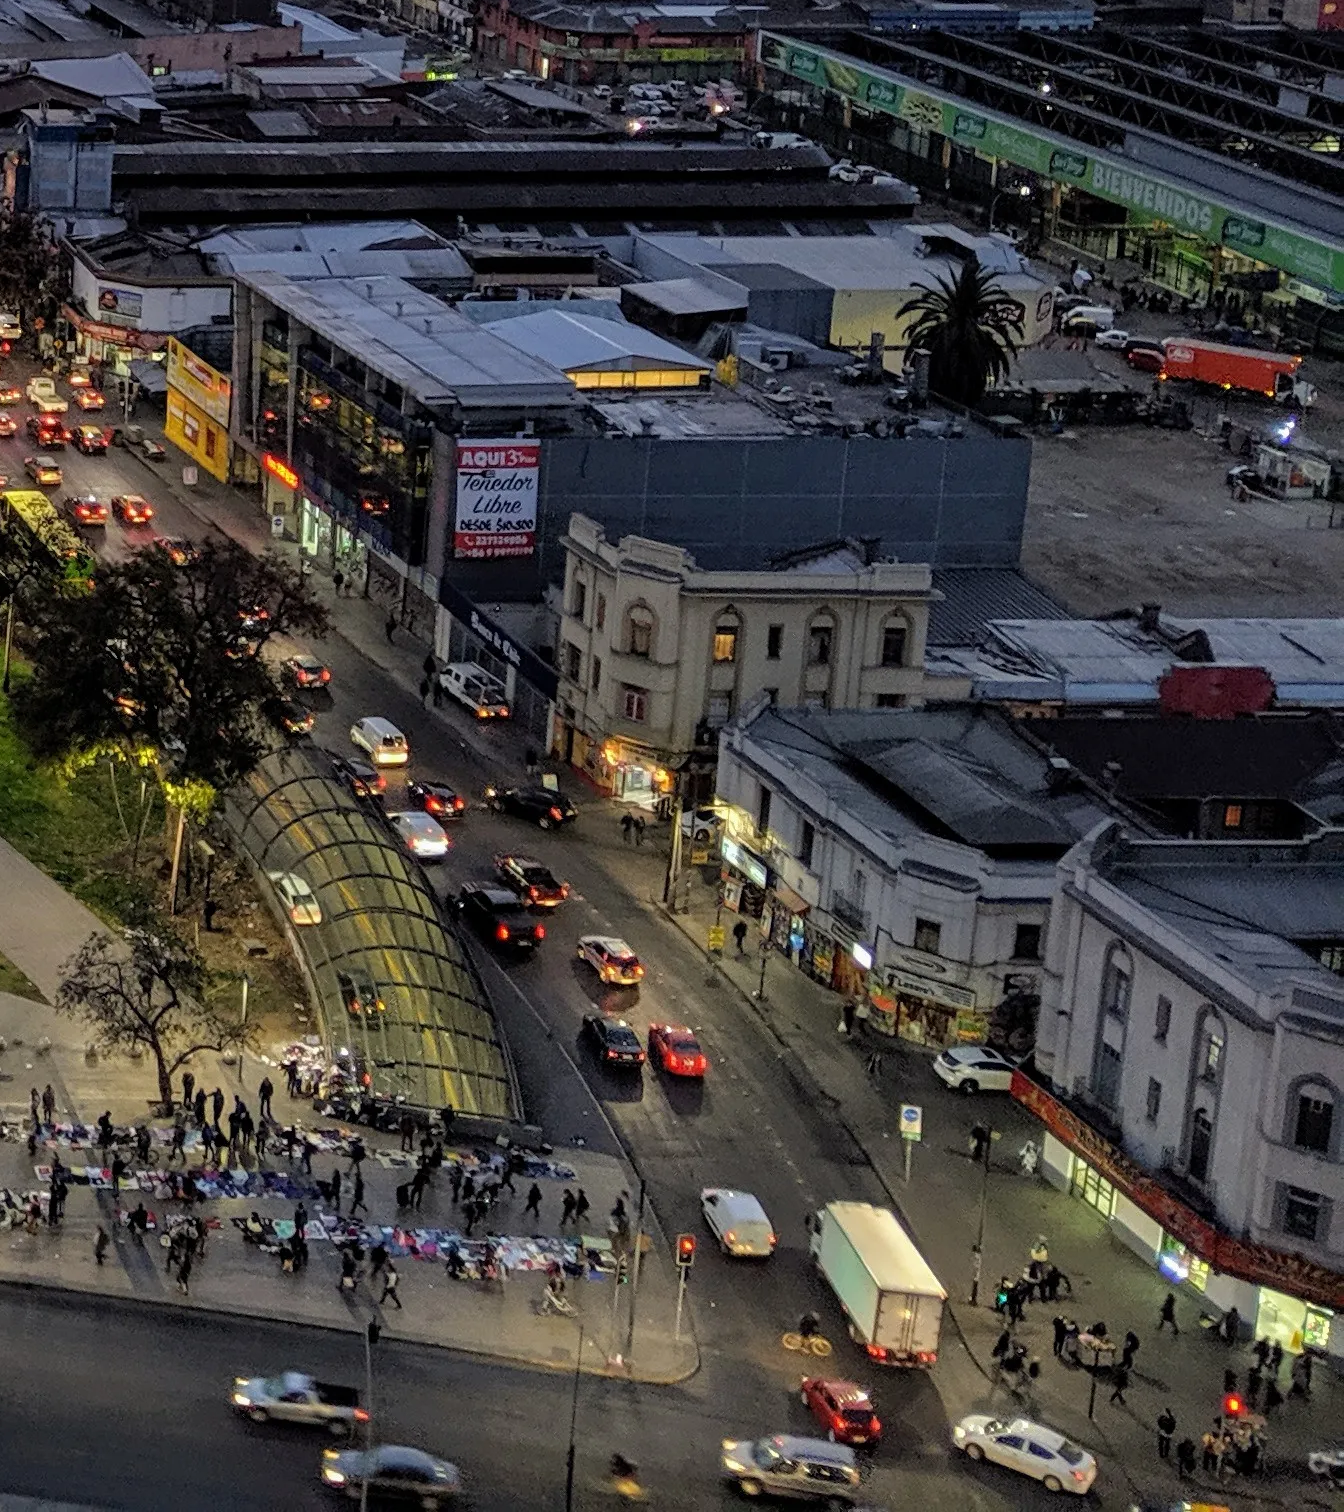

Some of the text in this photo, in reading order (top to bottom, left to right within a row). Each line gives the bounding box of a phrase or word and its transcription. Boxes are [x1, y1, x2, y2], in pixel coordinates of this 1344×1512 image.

[1092, 162, 1213, 232] BIENVENIDOS
[461, 450, 506, 468] AQUI
[459, 471, 534, 492] Tenedor
[472, 493, 523, 514] Libre
[460, 518, 491, 531] DESDE
